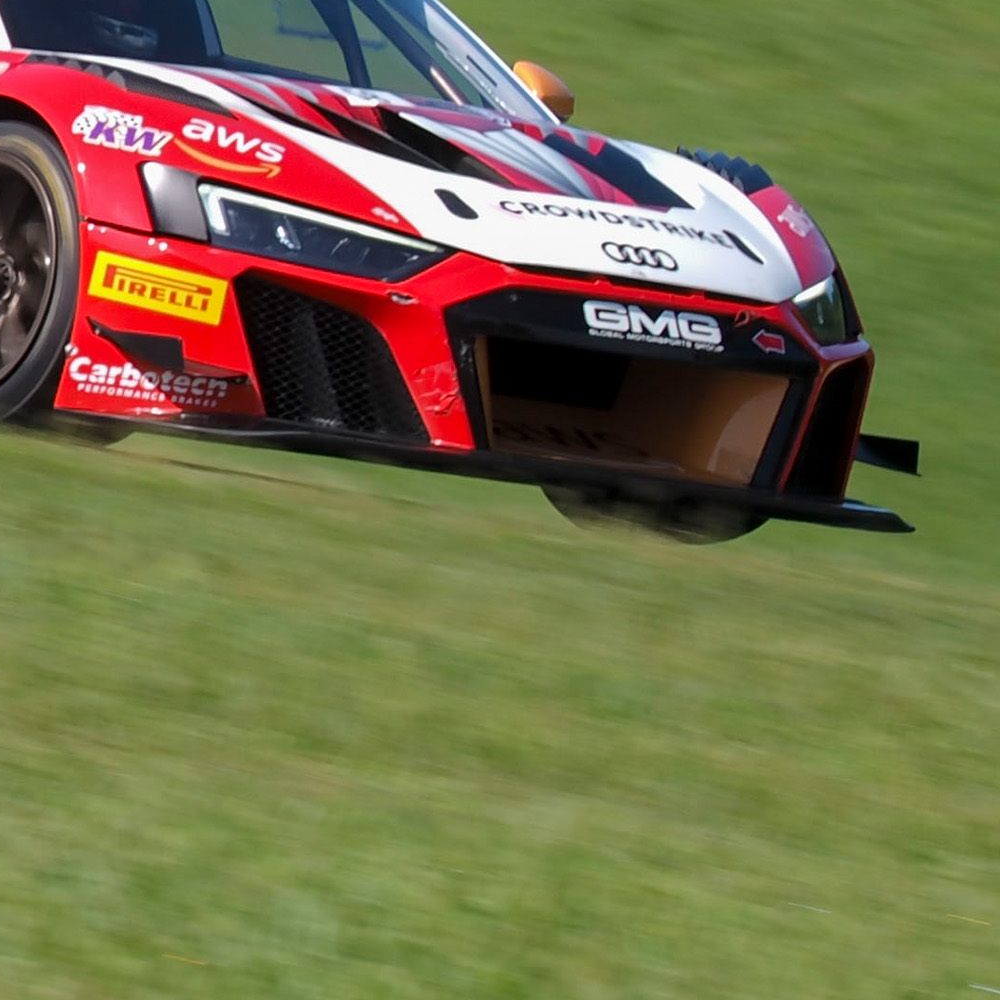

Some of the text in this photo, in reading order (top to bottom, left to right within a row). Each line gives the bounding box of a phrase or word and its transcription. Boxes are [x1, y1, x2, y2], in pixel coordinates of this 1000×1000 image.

[182, 117, 286, 163] aws
[499, 200, 736, 250] CROWDSTRIKE
[102, 263, 213, 313] PIRELLI
[583, 300, 723, 345] GMG
[77, 382, 168, 403] PERFORMANCE
